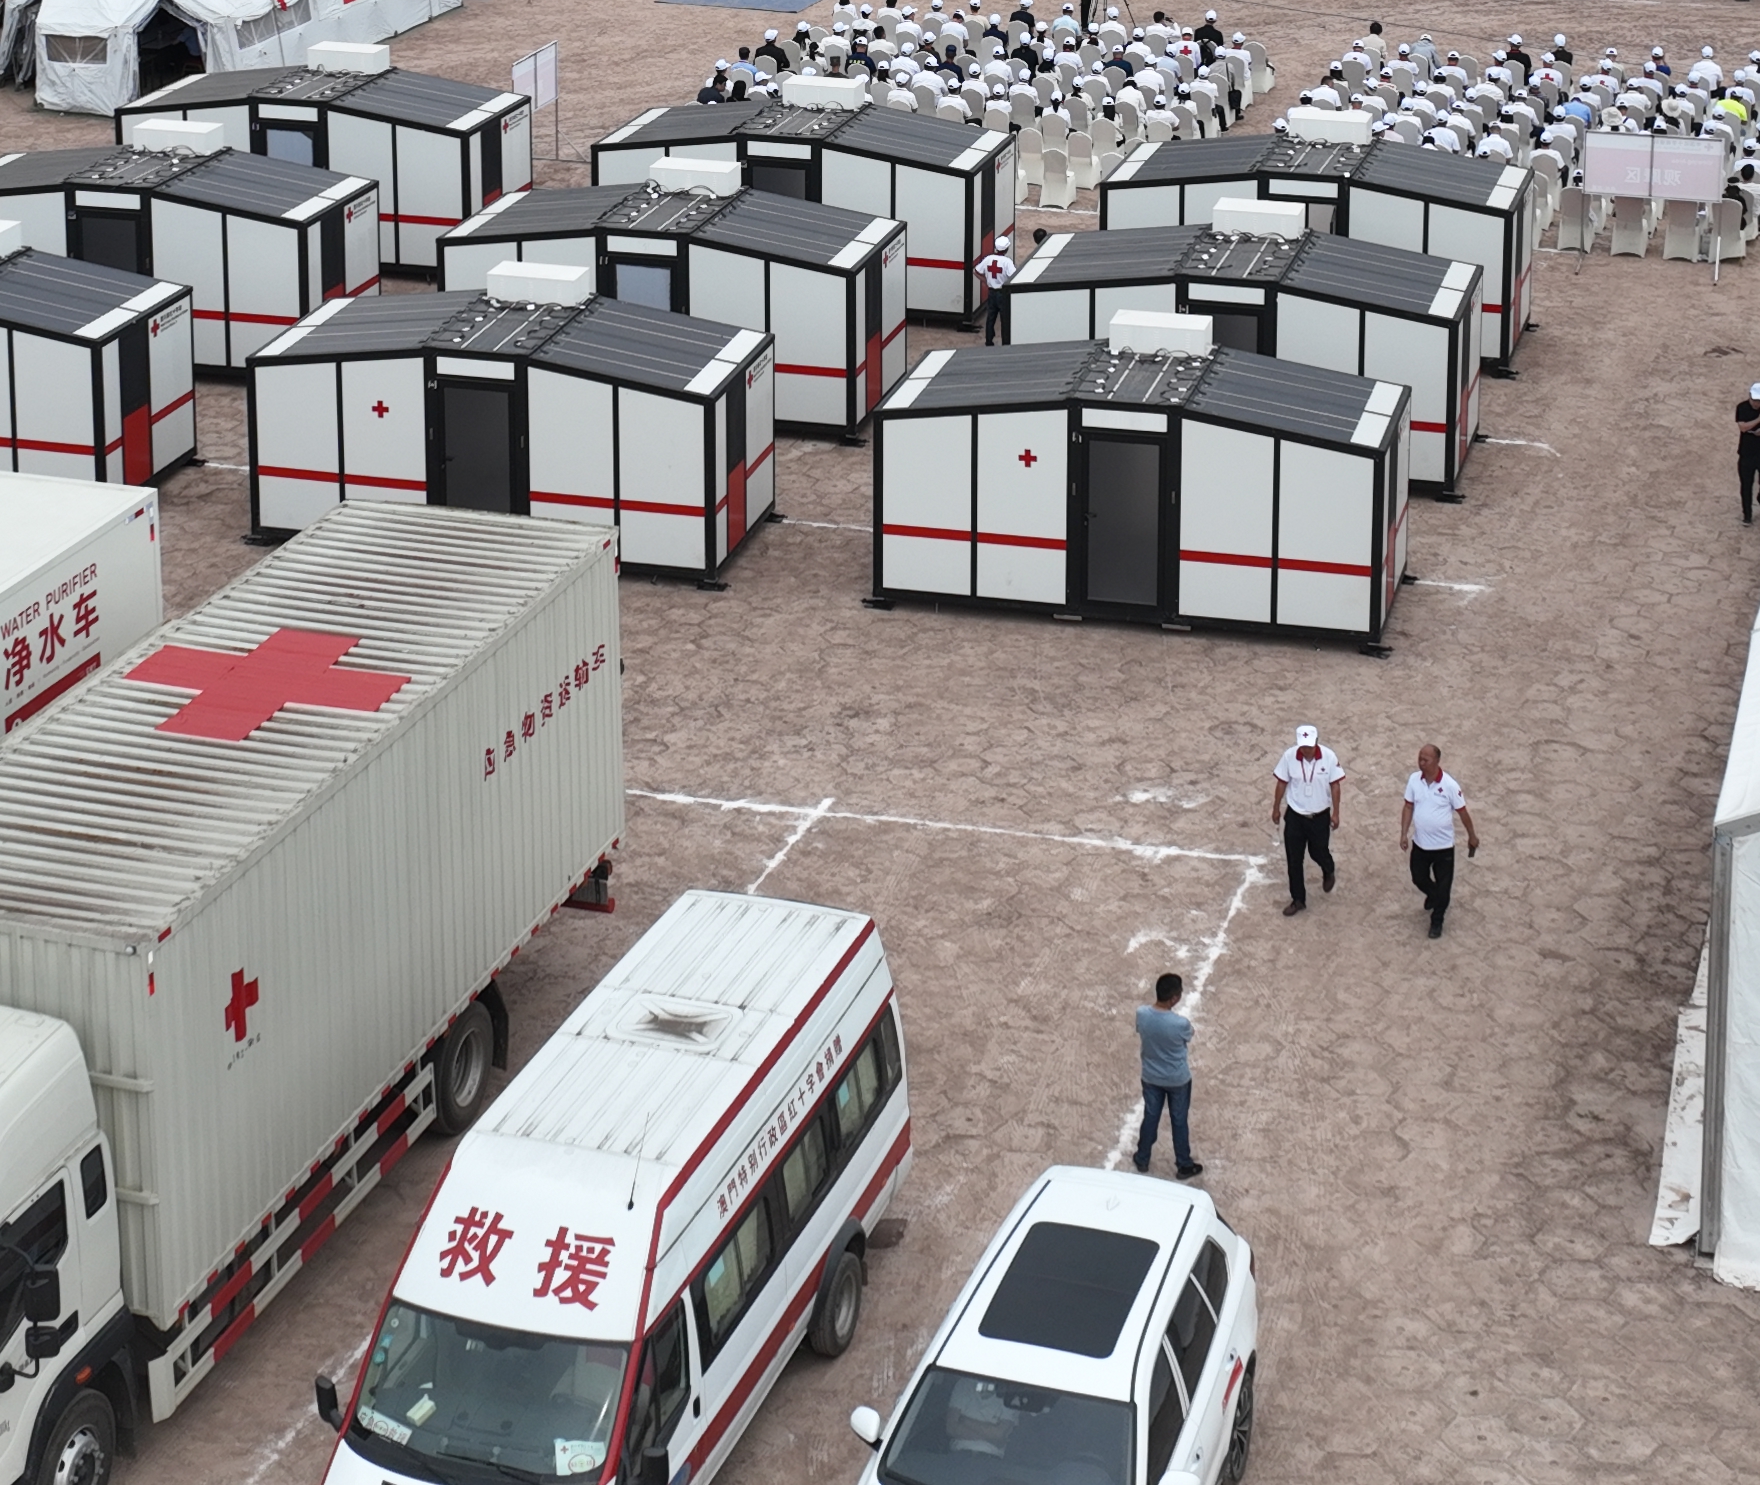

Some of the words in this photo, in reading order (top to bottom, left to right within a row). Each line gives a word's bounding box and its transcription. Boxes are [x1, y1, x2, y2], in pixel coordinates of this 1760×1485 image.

[0, 601, 41, 640] WATER
[45, 563, 98, 611] PURIFIER
[3, 589, 100, 691] 净水车
[439, 1206, 616, 1312] 救援
